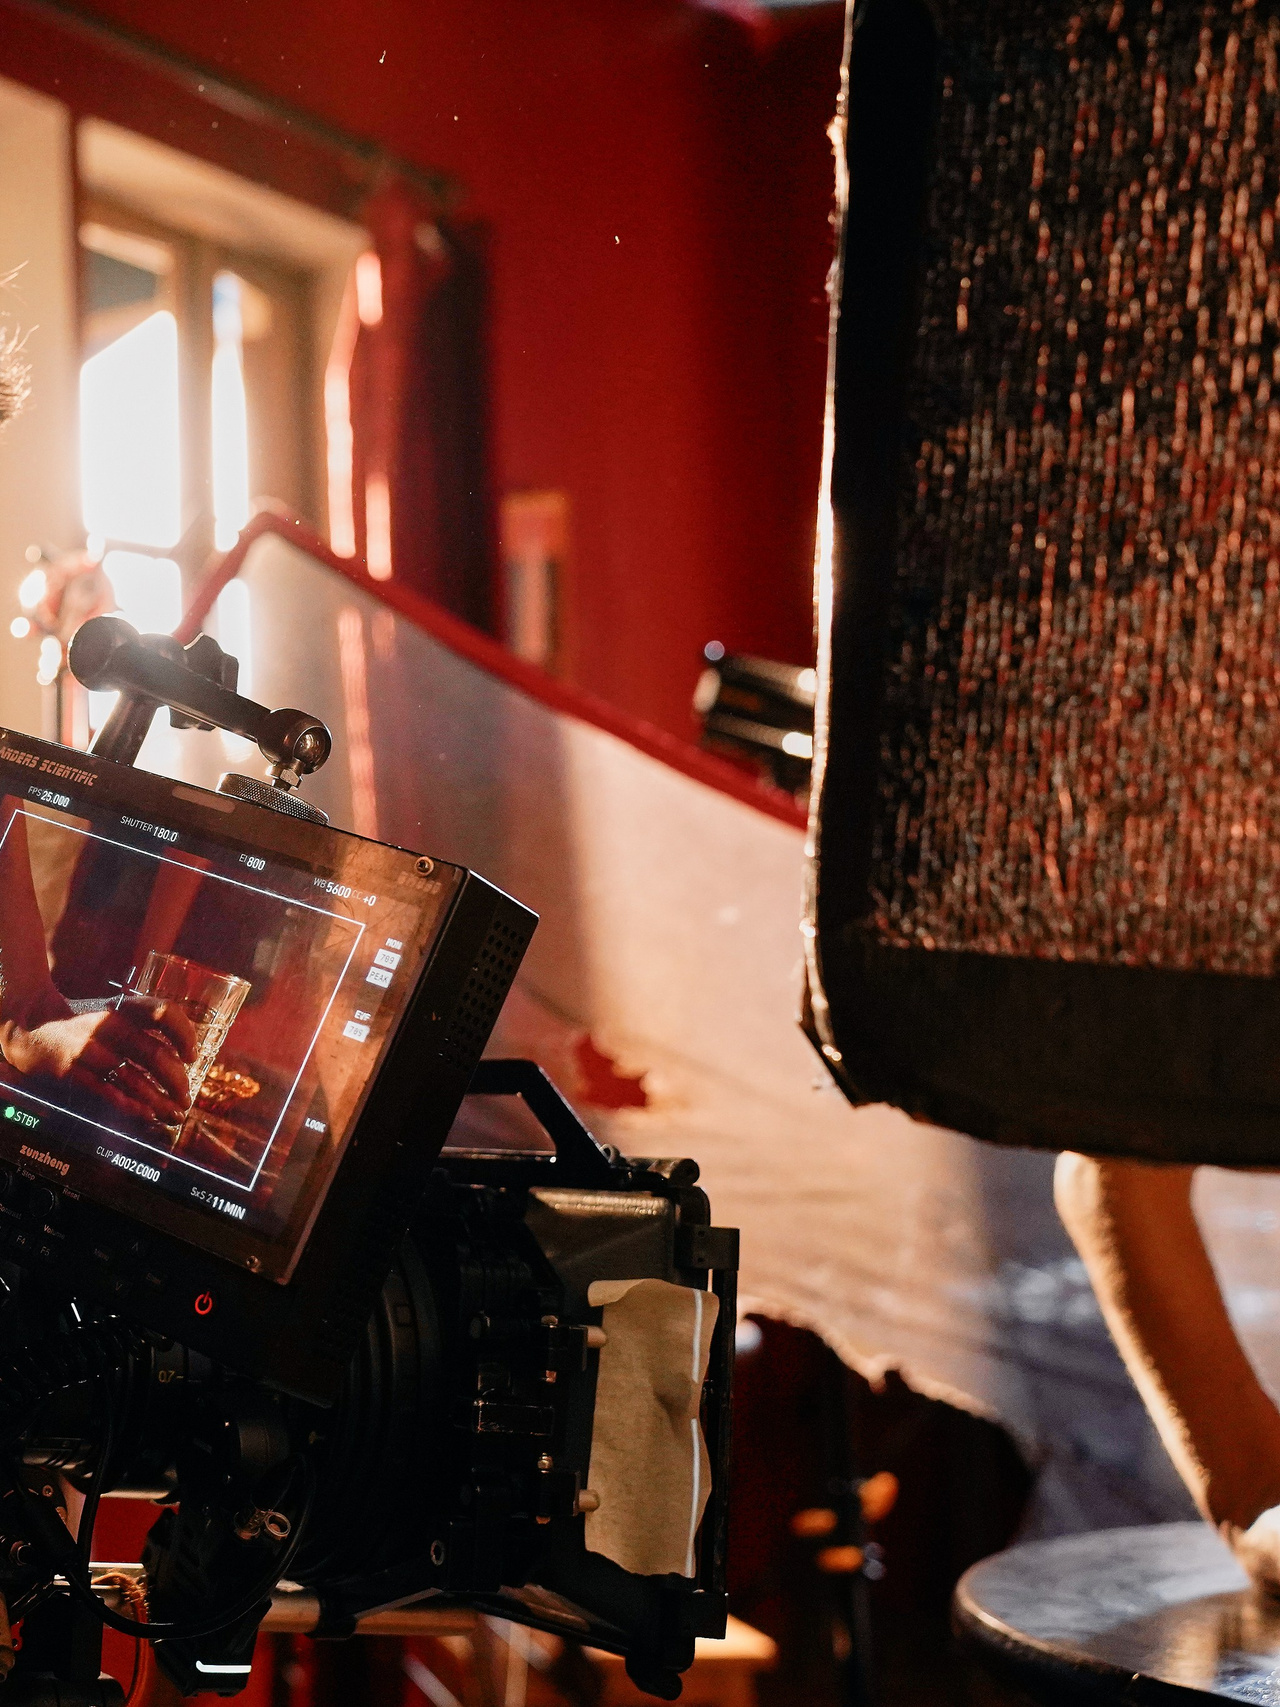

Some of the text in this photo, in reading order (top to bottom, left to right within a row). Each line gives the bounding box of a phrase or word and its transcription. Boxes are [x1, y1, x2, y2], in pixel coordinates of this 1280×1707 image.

[38, 759, 99, 787] SCIENTIFIC
[28, 786, 70, 808] FPS 25.000
[120, 815, 179, 843] SHUTTER 180.0
[239, 853, 266, 871] EI 800
[313, 877, 326, 888] WB
[326, 882, 351, 899] 5600
[363, 895, 377, 907] +0
[369, 971, 389, 984] PEAK
[14, 1111, 40, 1129] STBY
[305, 1117, 327, 1134] LOOK
[19, 1144, 71, 1177] zunzheng
[96, 1145, 114, 1159] CLIP
[224, 1200, 246, 1221] MIN
[16, 1234, 27, 1246] F4
